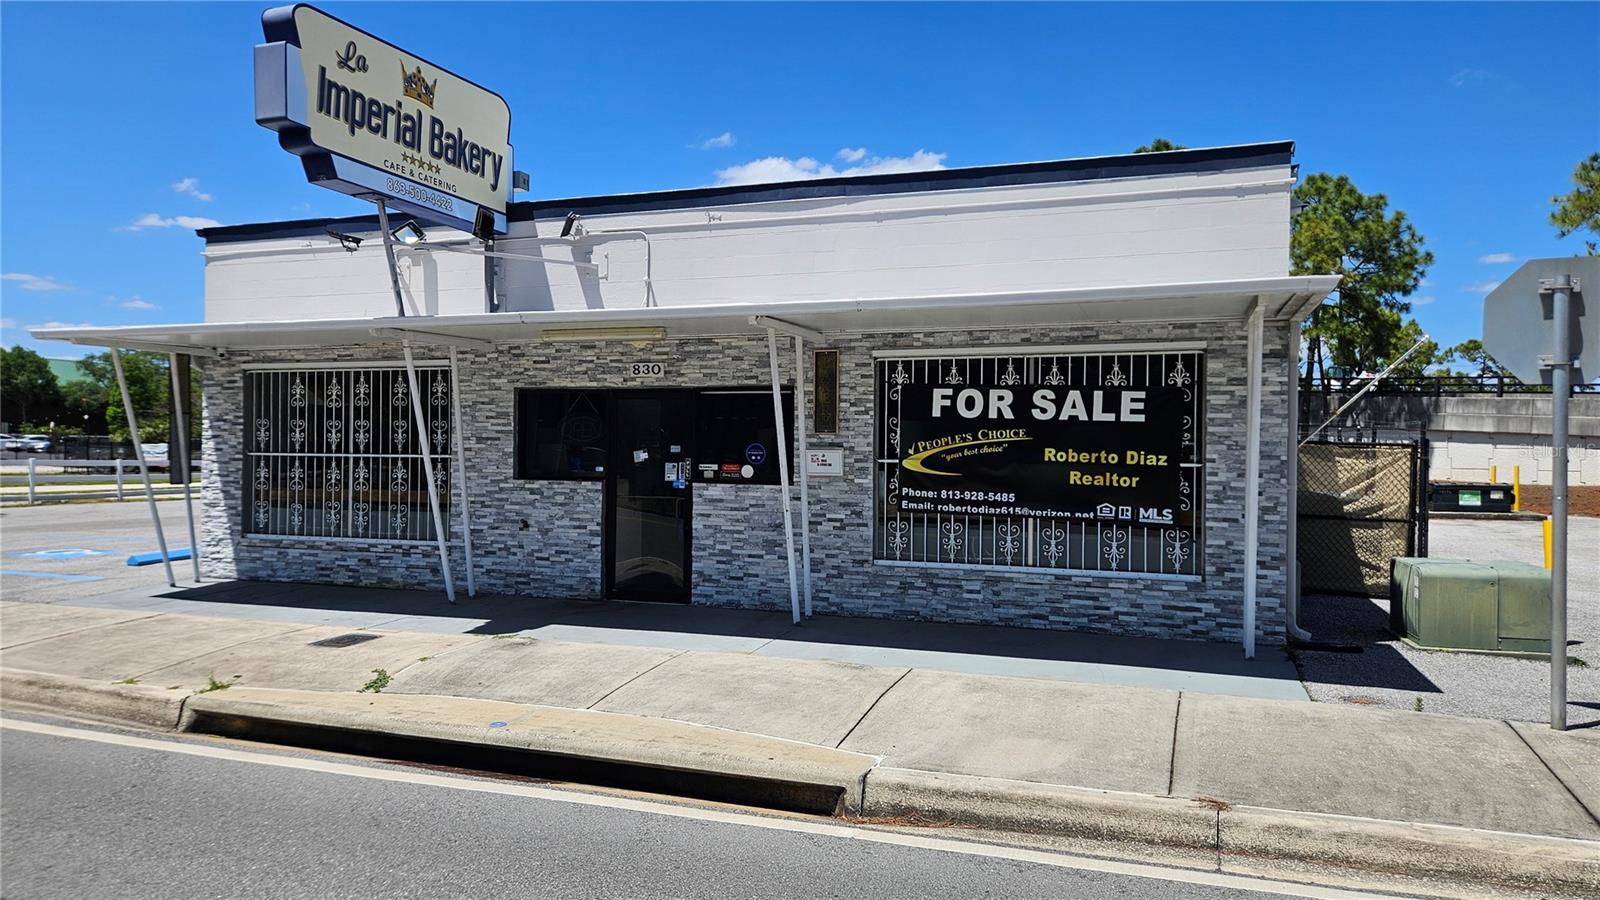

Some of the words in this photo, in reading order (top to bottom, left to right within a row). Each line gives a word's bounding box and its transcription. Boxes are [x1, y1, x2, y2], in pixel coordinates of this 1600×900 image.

[336, 41, 369, 73] La
[317, 64, 422, 153] Imperial
[428, 115, 503, 192] Bakery
[384, 159, 406, 174] CAFE
[409, 169, 415, 178] &
[418, 172, 457, 193] CATERING
[387, 177, 453, 211] 863-500-4422
[632, 364, 661, 375] 830
[931, 388, 1015, 419] FOR
[1031, 389, 1146, 422] SALE
[963, 448, 978, 456] best
[1044, 448, 1119, 464] Roberto
[1126, 450, 1168, 466] Diaz
[1069, 471, 1140, 488] Realtor
[902, 488, 938, 498] Phone:
[940, 490, 1016, 502] 813-928-5485
[901, 501, 935, 511] Email:
[938, 504, 1094, 518] robertodiaz615@verizon.net
[1139, 507, 1173, 520] MLS
